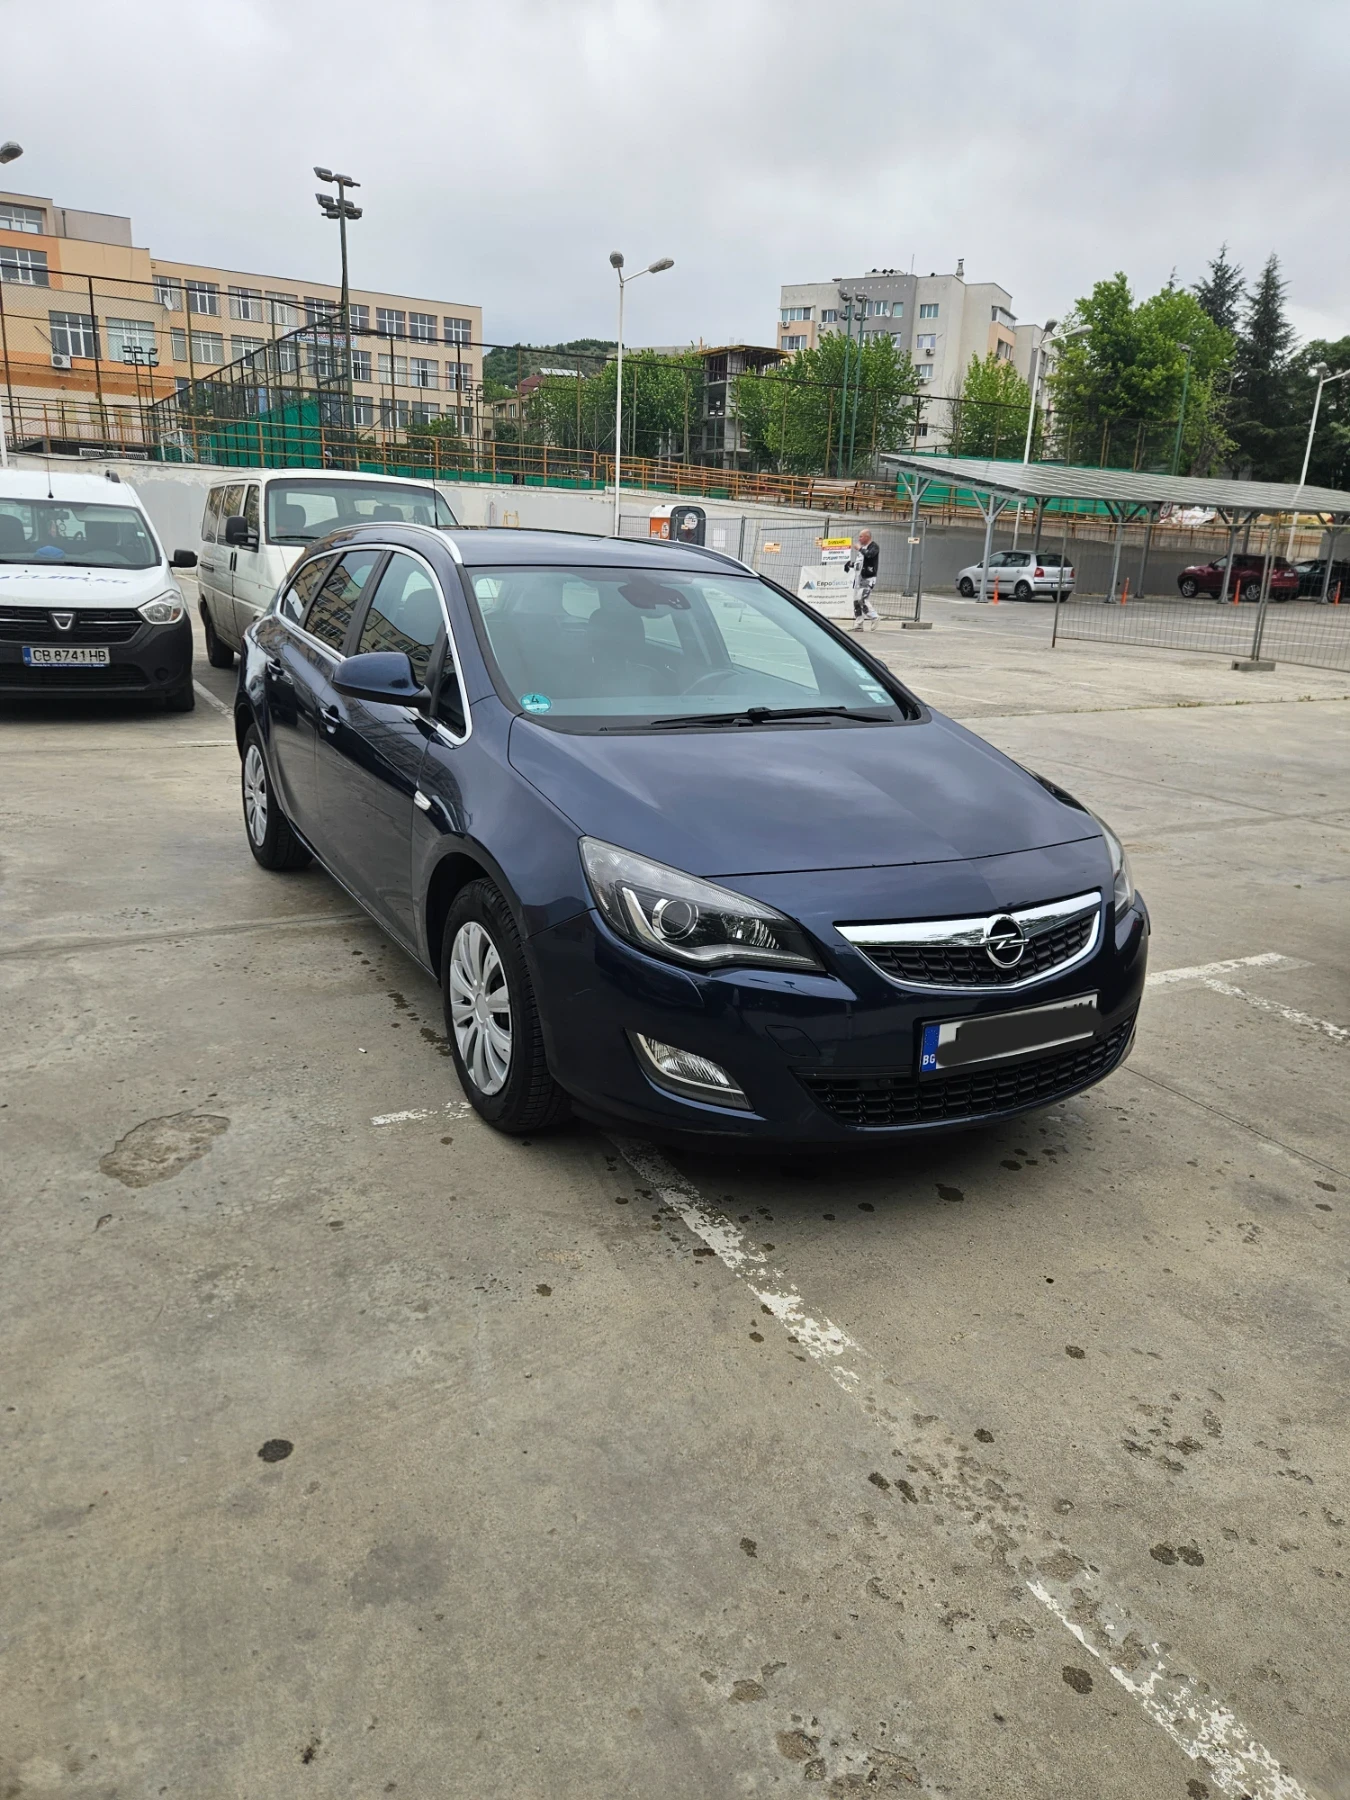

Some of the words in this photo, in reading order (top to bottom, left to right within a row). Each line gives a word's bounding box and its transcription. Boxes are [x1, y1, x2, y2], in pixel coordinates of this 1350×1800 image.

[32, 650, 52, 662] CB
[54, 650, 86, 662] 8741
[88, 650, 106, 662] HB
[532, 695, 540, 704] 4
[922, 1053, 936, 1066] BG
